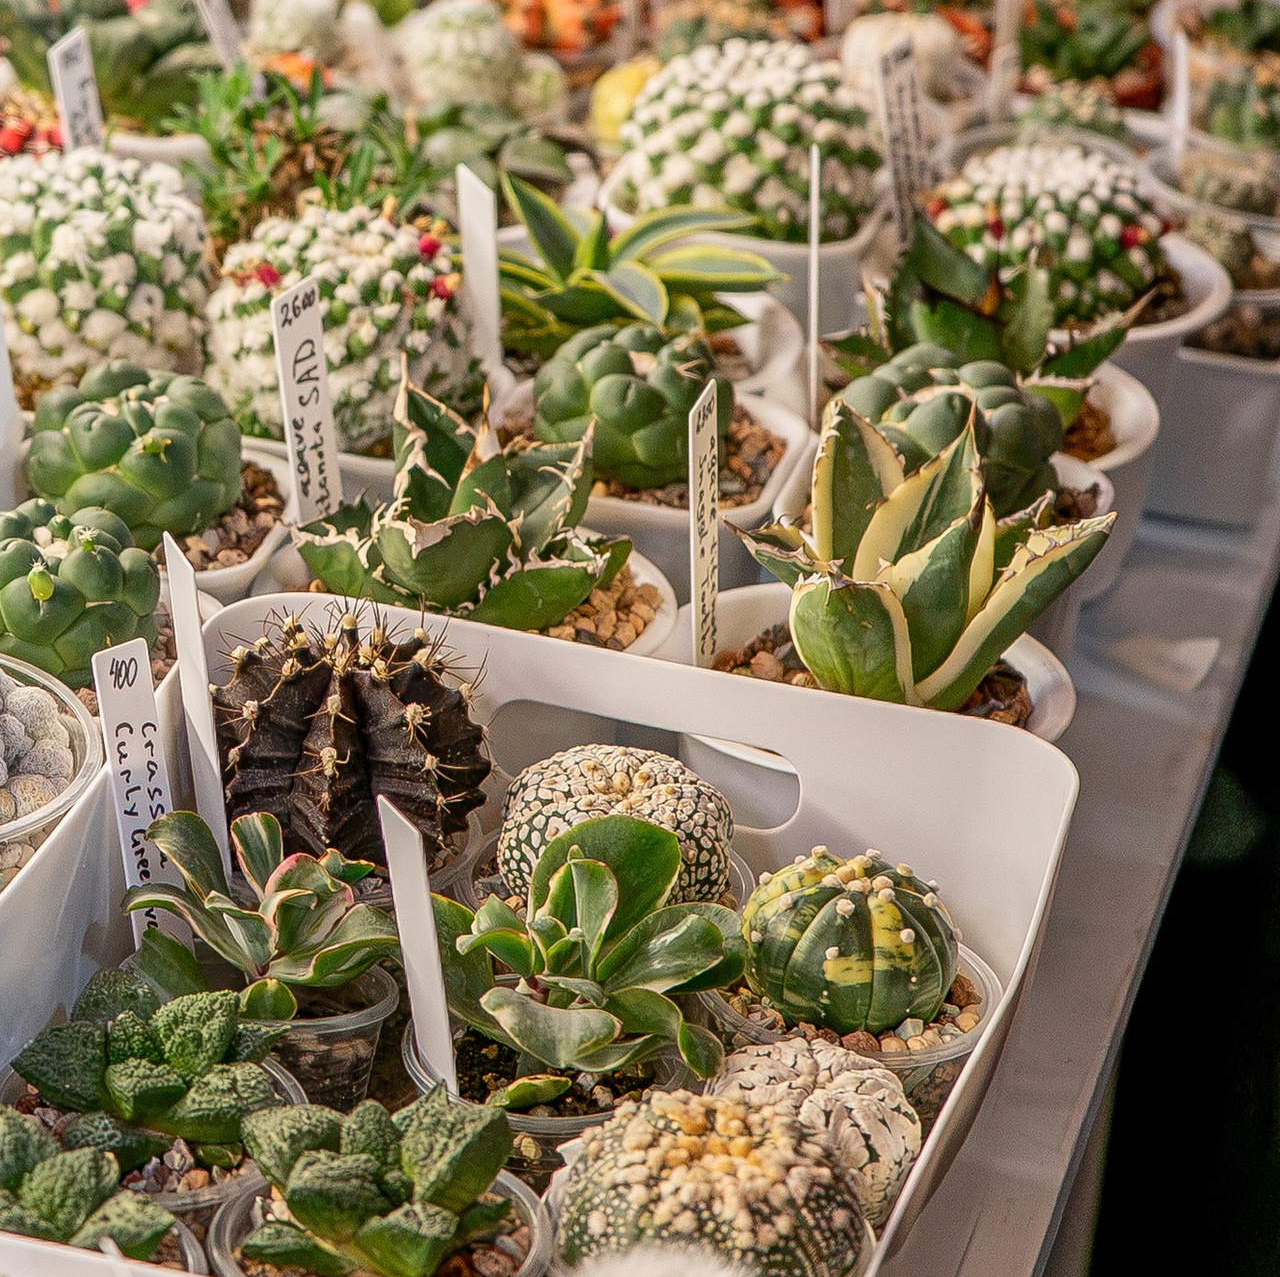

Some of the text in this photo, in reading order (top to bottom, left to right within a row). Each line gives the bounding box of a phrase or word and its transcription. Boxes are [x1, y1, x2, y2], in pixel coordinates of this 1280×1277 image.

[293, 338, 319, 408] SAD
[109, 656, 139, 690] 400
[114, 721, 143, 818] Curly
[130, 828, 152, 884] Gree
[141, 721, 169, 870] Crassa
